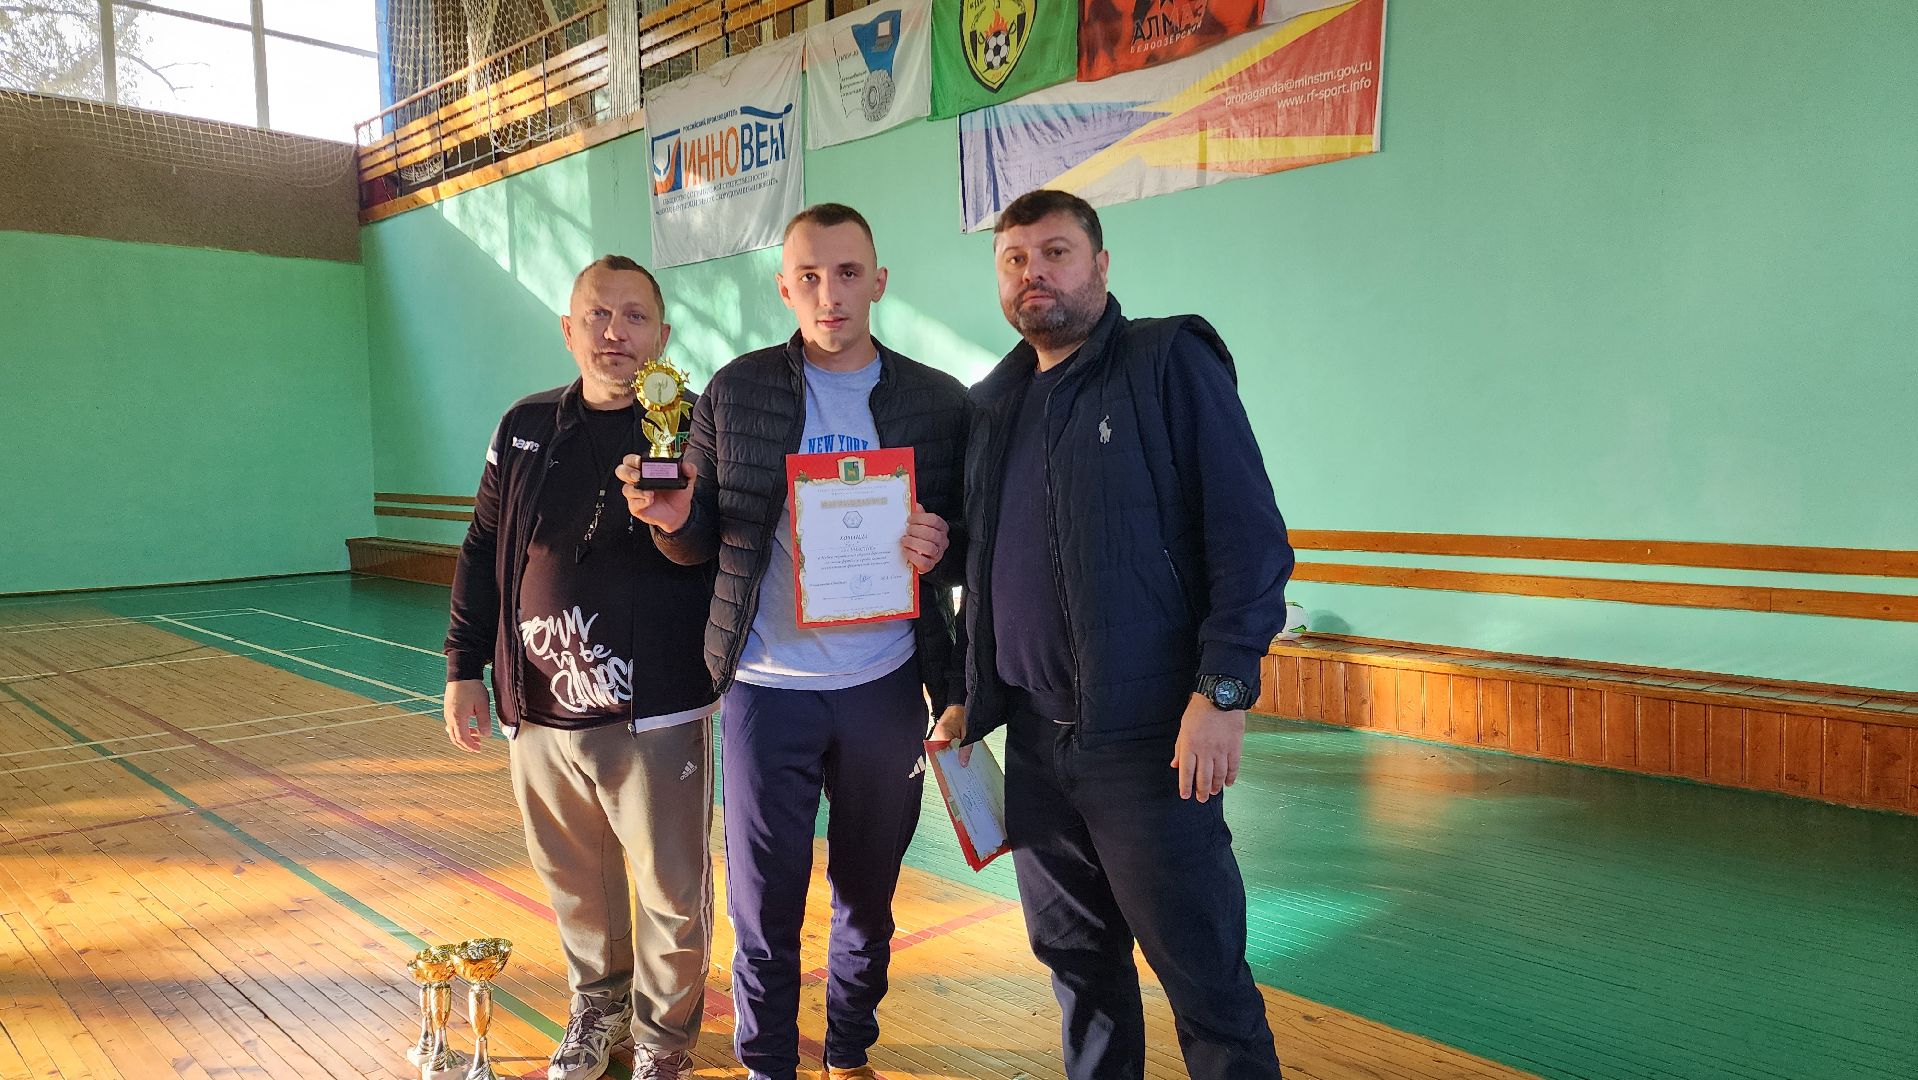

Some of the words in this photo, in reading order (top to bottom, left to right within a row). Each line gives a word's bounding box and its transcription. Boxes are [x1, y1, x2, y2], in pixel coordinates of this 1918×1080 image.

[1225, 61, 1372, 108] propaganda@minstm.gov.ru
[1277, 77, 1372, 109] www.rf-sport.info
[808, 434, 835, 454] NEW
[579, 641, 612, 663] be
